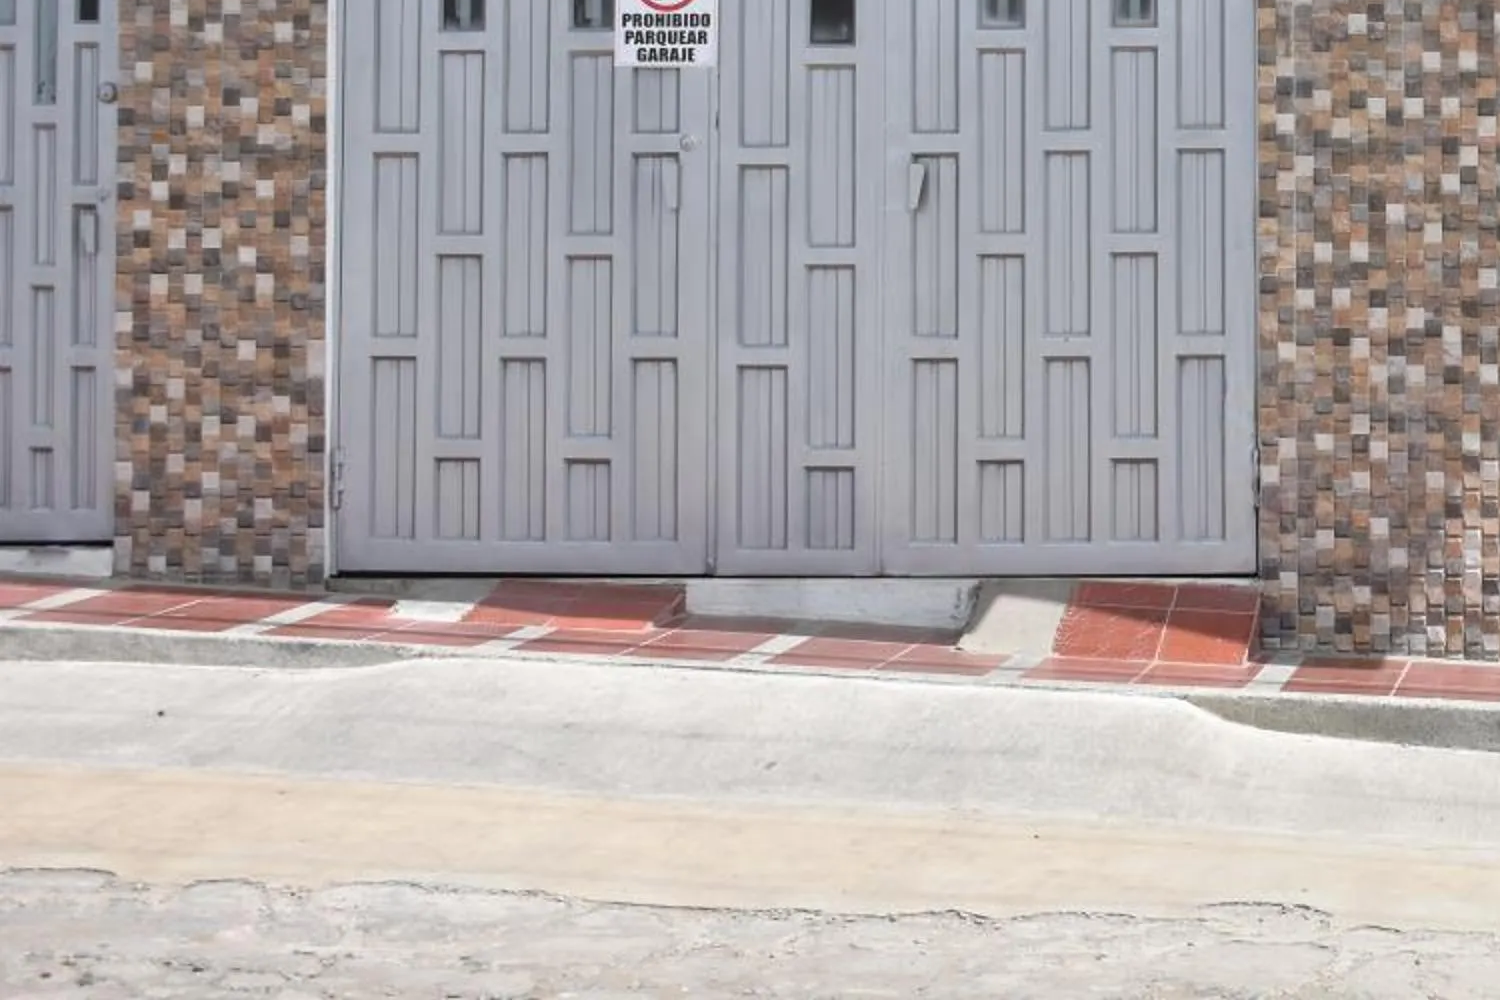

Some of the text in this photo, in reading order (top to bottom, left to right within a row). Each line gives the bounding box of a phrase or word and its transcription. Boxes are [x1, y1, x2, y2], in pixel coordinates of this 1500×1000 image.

[622, 13, 712, 28] PROHIBIDO
[624, 30, 708, 46] PARQUEAR
[637, 47, 697, 63] GARAJE
